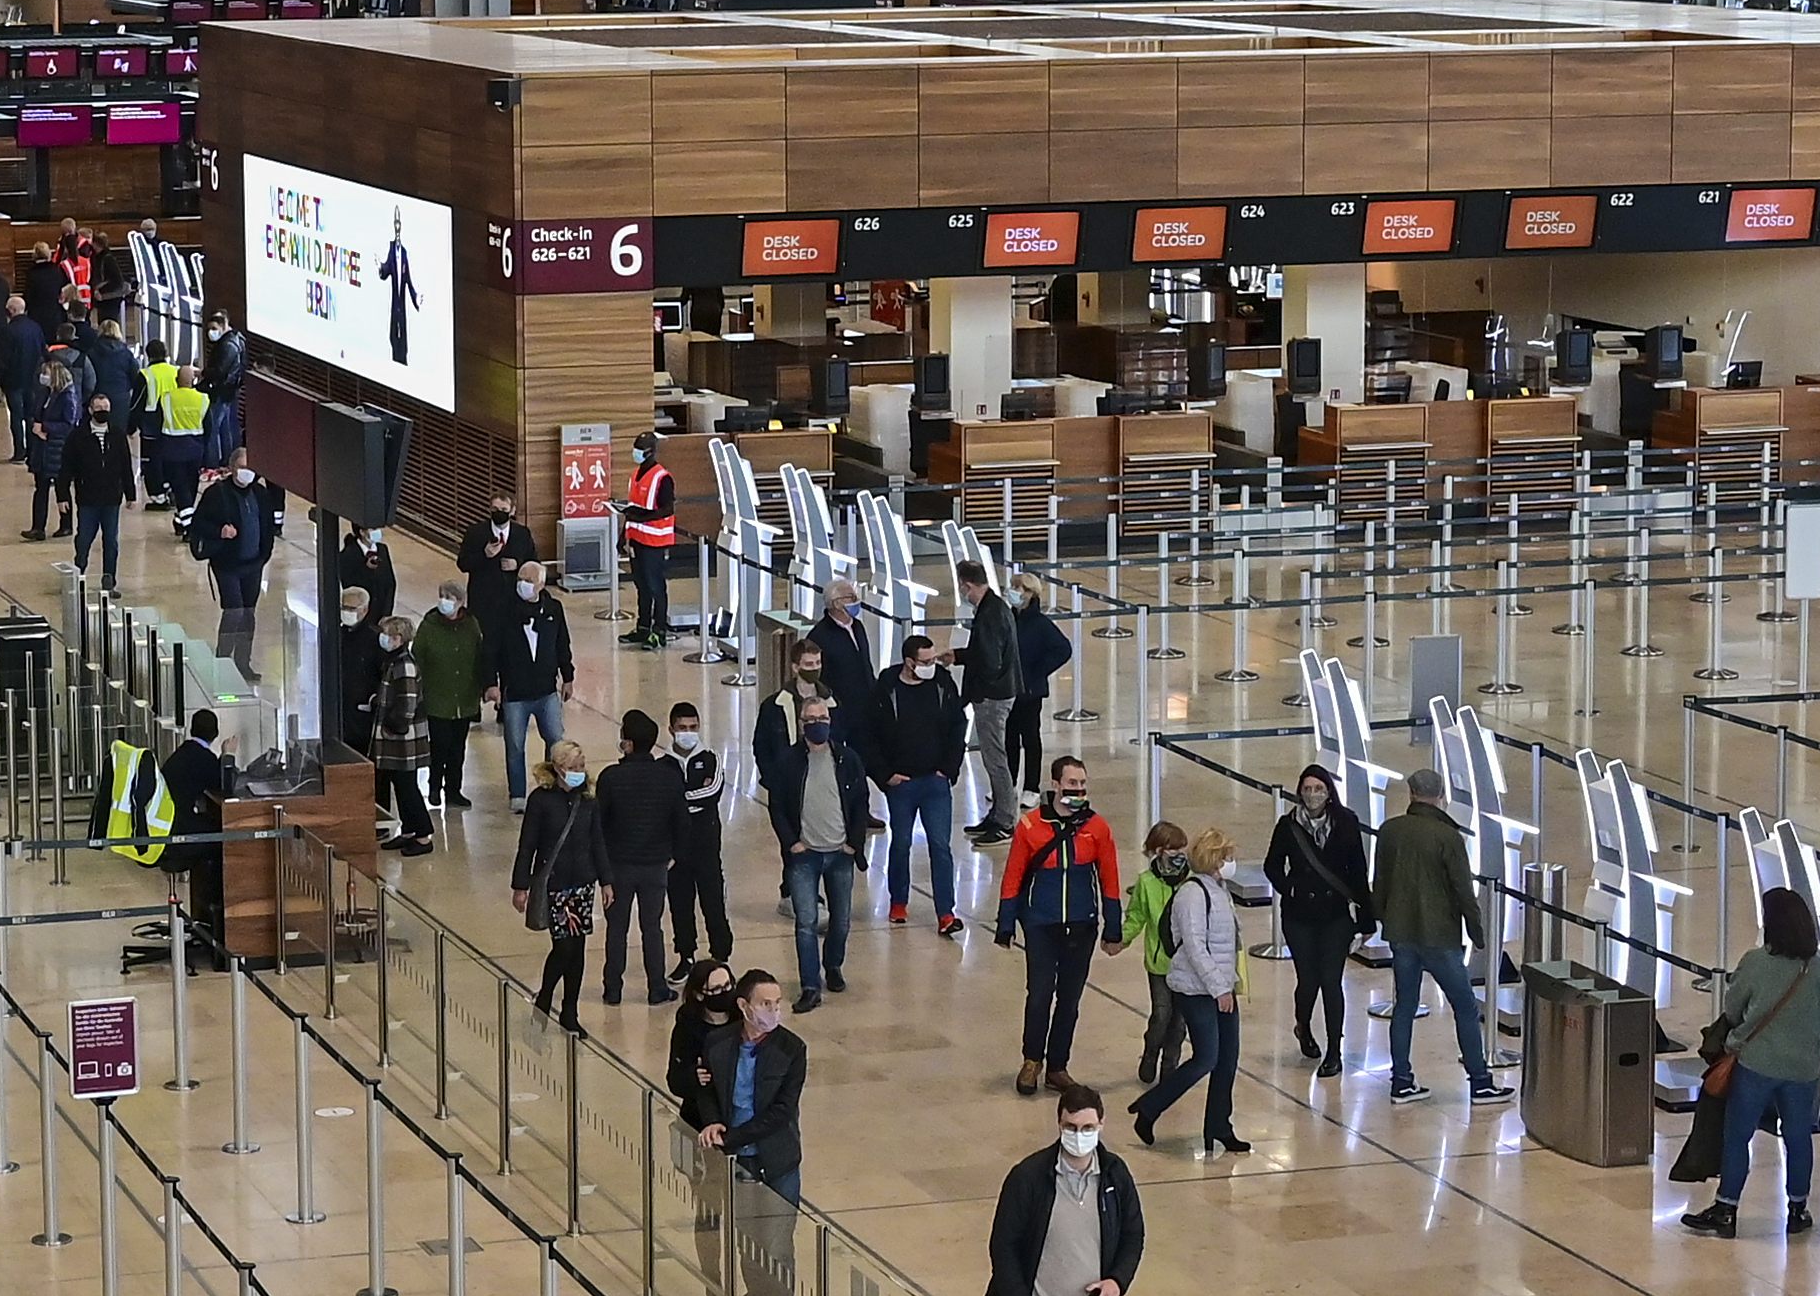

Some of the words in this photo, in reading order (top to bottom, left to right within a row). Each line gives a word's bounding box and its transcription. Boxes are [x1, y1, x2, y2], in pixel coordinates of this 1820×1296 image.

[211, 149, 218, 191] 6
[1610, 193, 1634, 206] 622
[1698, 191, 1720, 203] 621
[1241, 205, 1265, 218] 624
[1331, 203, 1355, 215] 623
[1746, 204, 1779, 215] DESK
[948, 215, 973, 228] 625
[1384, 215, 1418, 227] DESK
[1526, 211, 1561, 222] DESK
[1744, 215, 1794, 228] CLOSED
[854, 217, 880, 230] 626
[1154, 223, 1189, 235] DESK
[1525, 222, 1575, 235] CLOSED
[531, 225, 592, 242] Check-in
[1005, 227, 1040, 240] DESK
[1382, 227, 1434, 240] CLOSED
[764, 235, 800, 248] DESK
[1003, 240, 1058, 253] CLOSED
[1152, 234, 1205, 247] CLOSED
[502, 228, 513, 278] 6
[610, 224, 643, 276] 6
[763, 247, 818, 261] CLOSED
